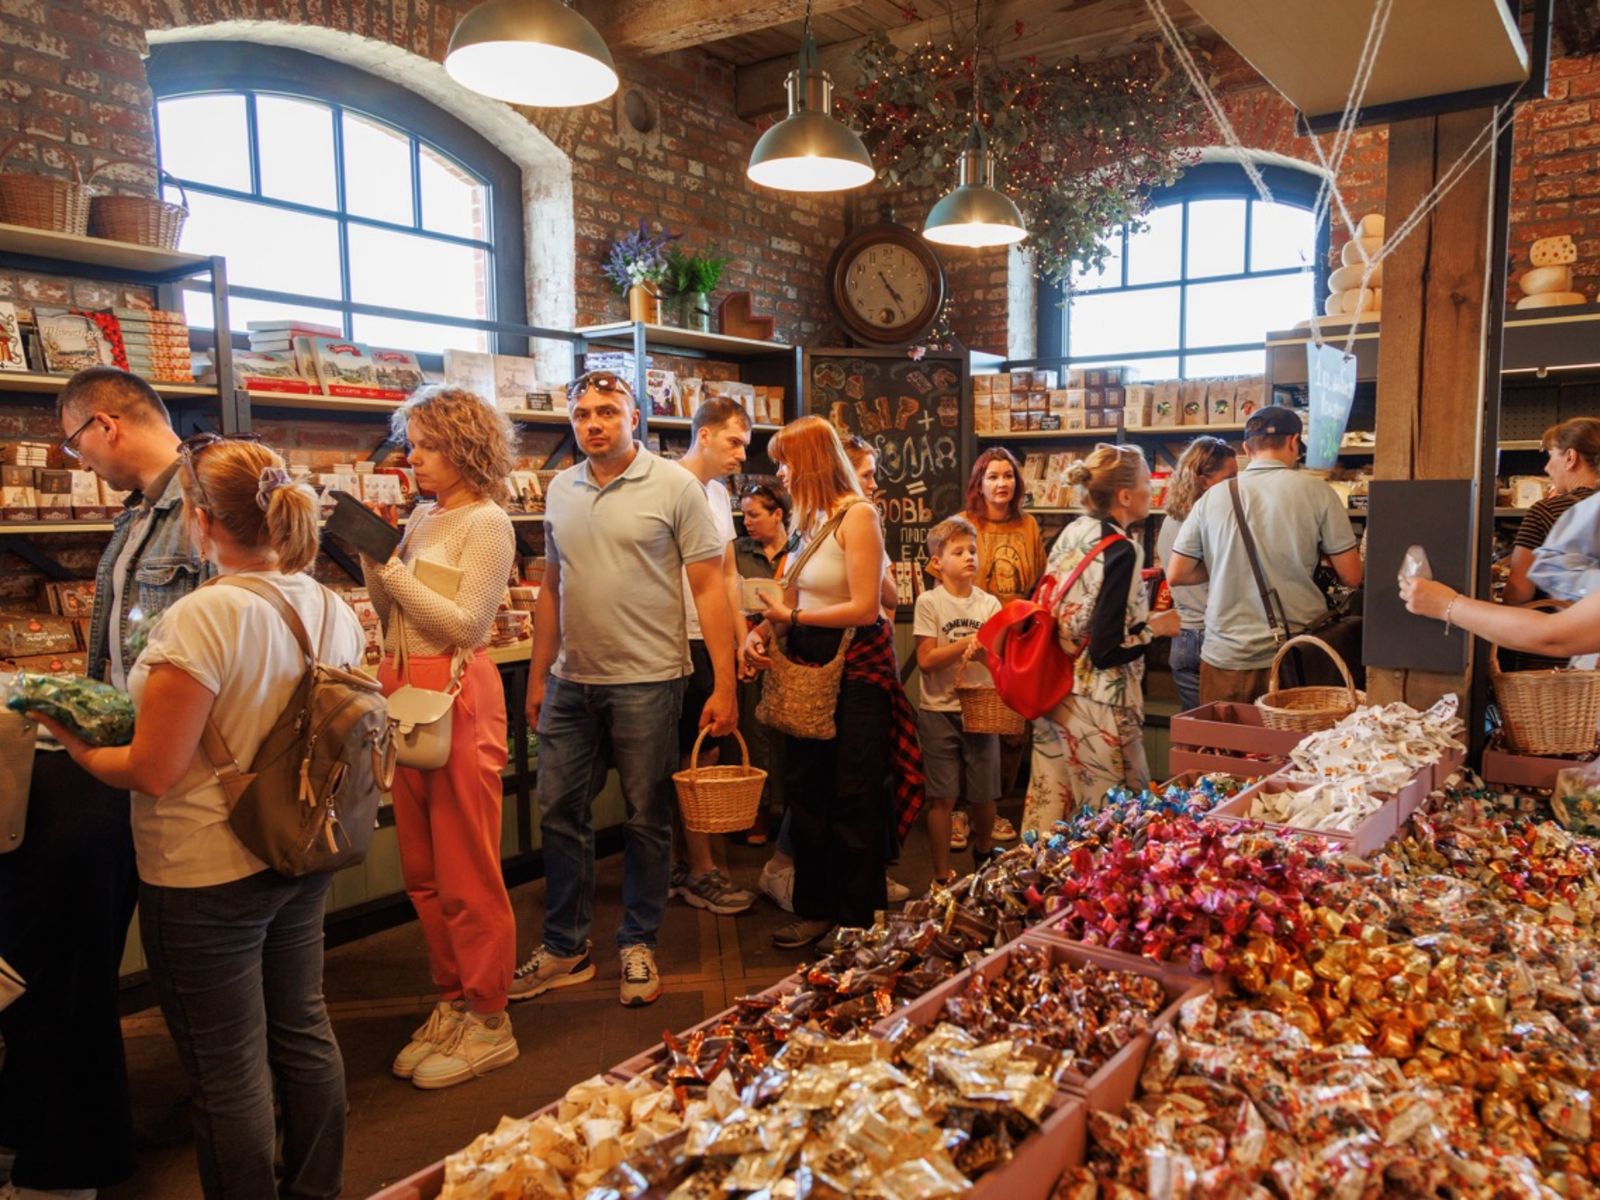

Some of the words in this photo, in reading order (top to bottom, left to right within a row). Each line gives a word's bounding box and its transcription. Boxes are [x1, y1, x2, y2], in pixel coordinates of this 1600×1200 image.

[873, 433, 958, 481] КОЛАД
[874, 488, 933, 524] БОВЬ
[900, 527, 930, 544] ПРОС
[901, 544, 930, 567] ЕД
[942, 617, 984, 635] SOMEWHE
